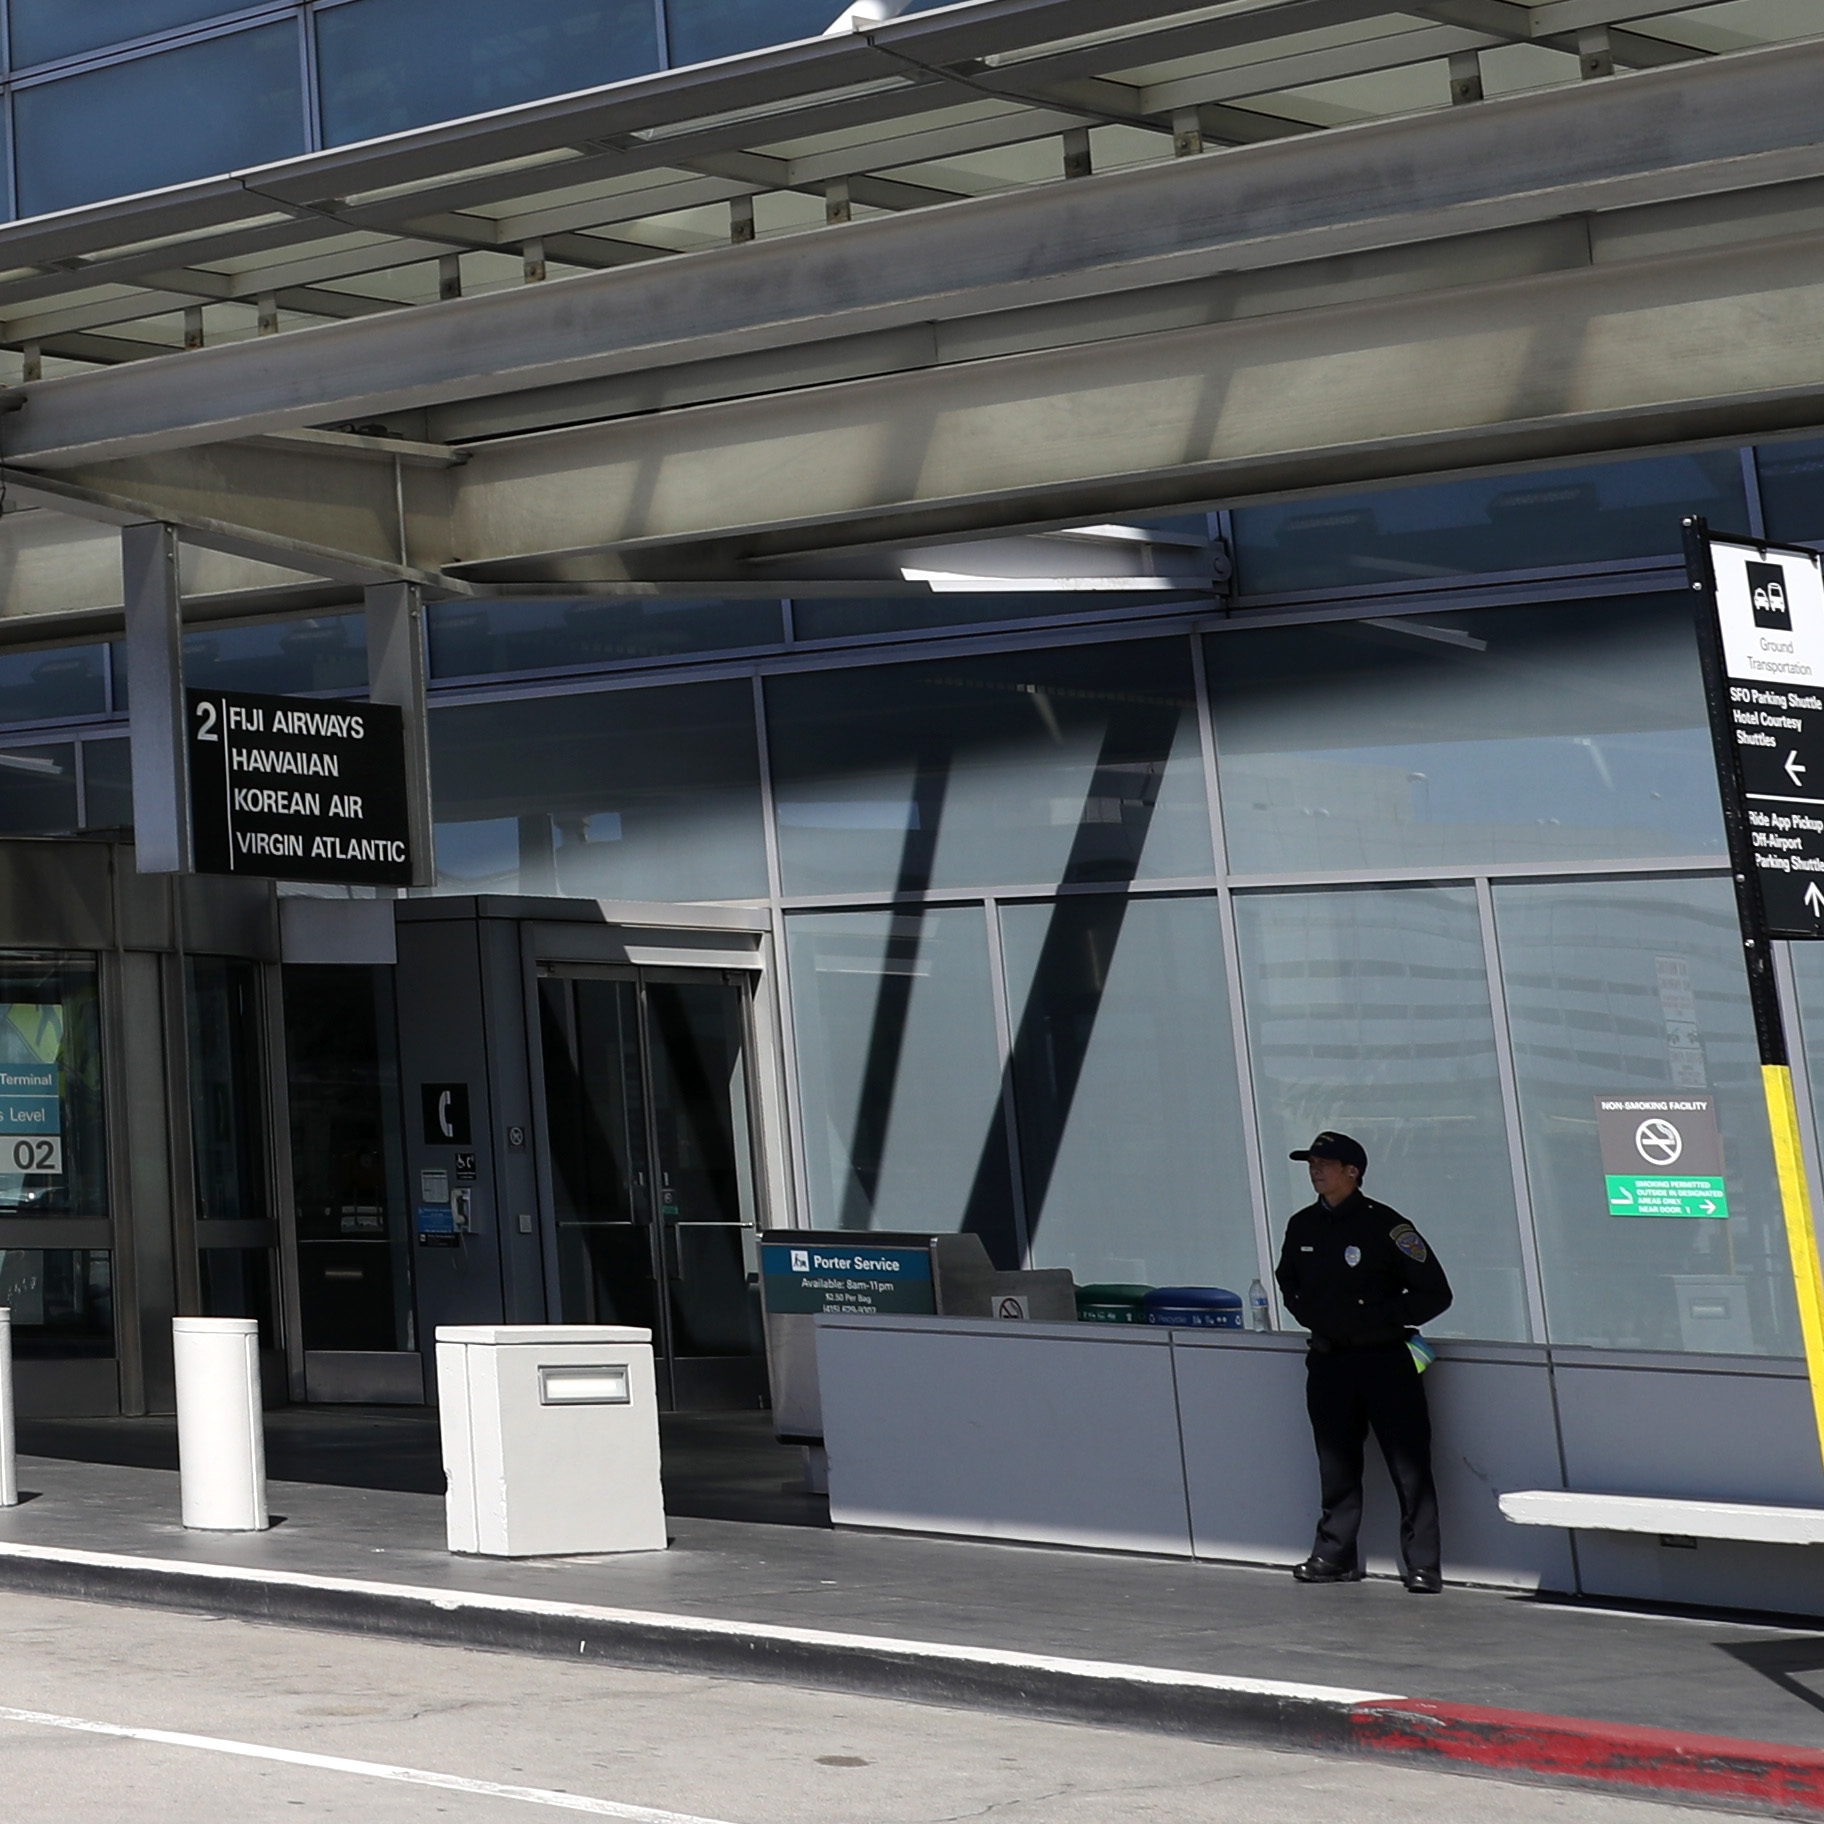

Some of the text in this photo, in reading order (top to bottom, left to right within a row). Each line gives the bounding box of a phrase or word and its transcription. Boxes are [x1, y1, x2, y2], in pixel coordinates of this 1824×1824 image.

[1759, 637, 1794, 654] Ground
[1747, 656, 1813, 676] Transportation
[1730, 686, 1823, 711] SFO Parking Shuttle
[196, 701, 219, 742] 2
[229, 706, 365, 739] FIJI AIRWAYS
[1733, 709, 1802, 733] Hotel Courtesy
[1736, 729, 1776, 747] Shuttles
[231, 747, 339, 777] HAWAIIAN
[234, 787, 364, 819] KOREAN AIR
[1748, 810, 1824, 834] Ride App Pickup
[236, 831, 406, 863] VIRGIN ATLANTIC
[1752, 831, 1803, 852] Off-Airport
[1754, 852, 1791, 873] Parking
[10, 1107, 46, 1123] Level
[1601, 1101, 1707, 1111] NON-SMOKING FACILITY
[13, 1140, 56, 1170] 02
[1635, 1180, 1711, 1189] SMOKING PERMITTED
[813, 1254, 900, 1272] Porter Service
[801, 1278, 894, 1293] Available: 8am-11pm
[845, 1293, 856, 1302] Per
[857, 1293, 872, 1304] Bag
